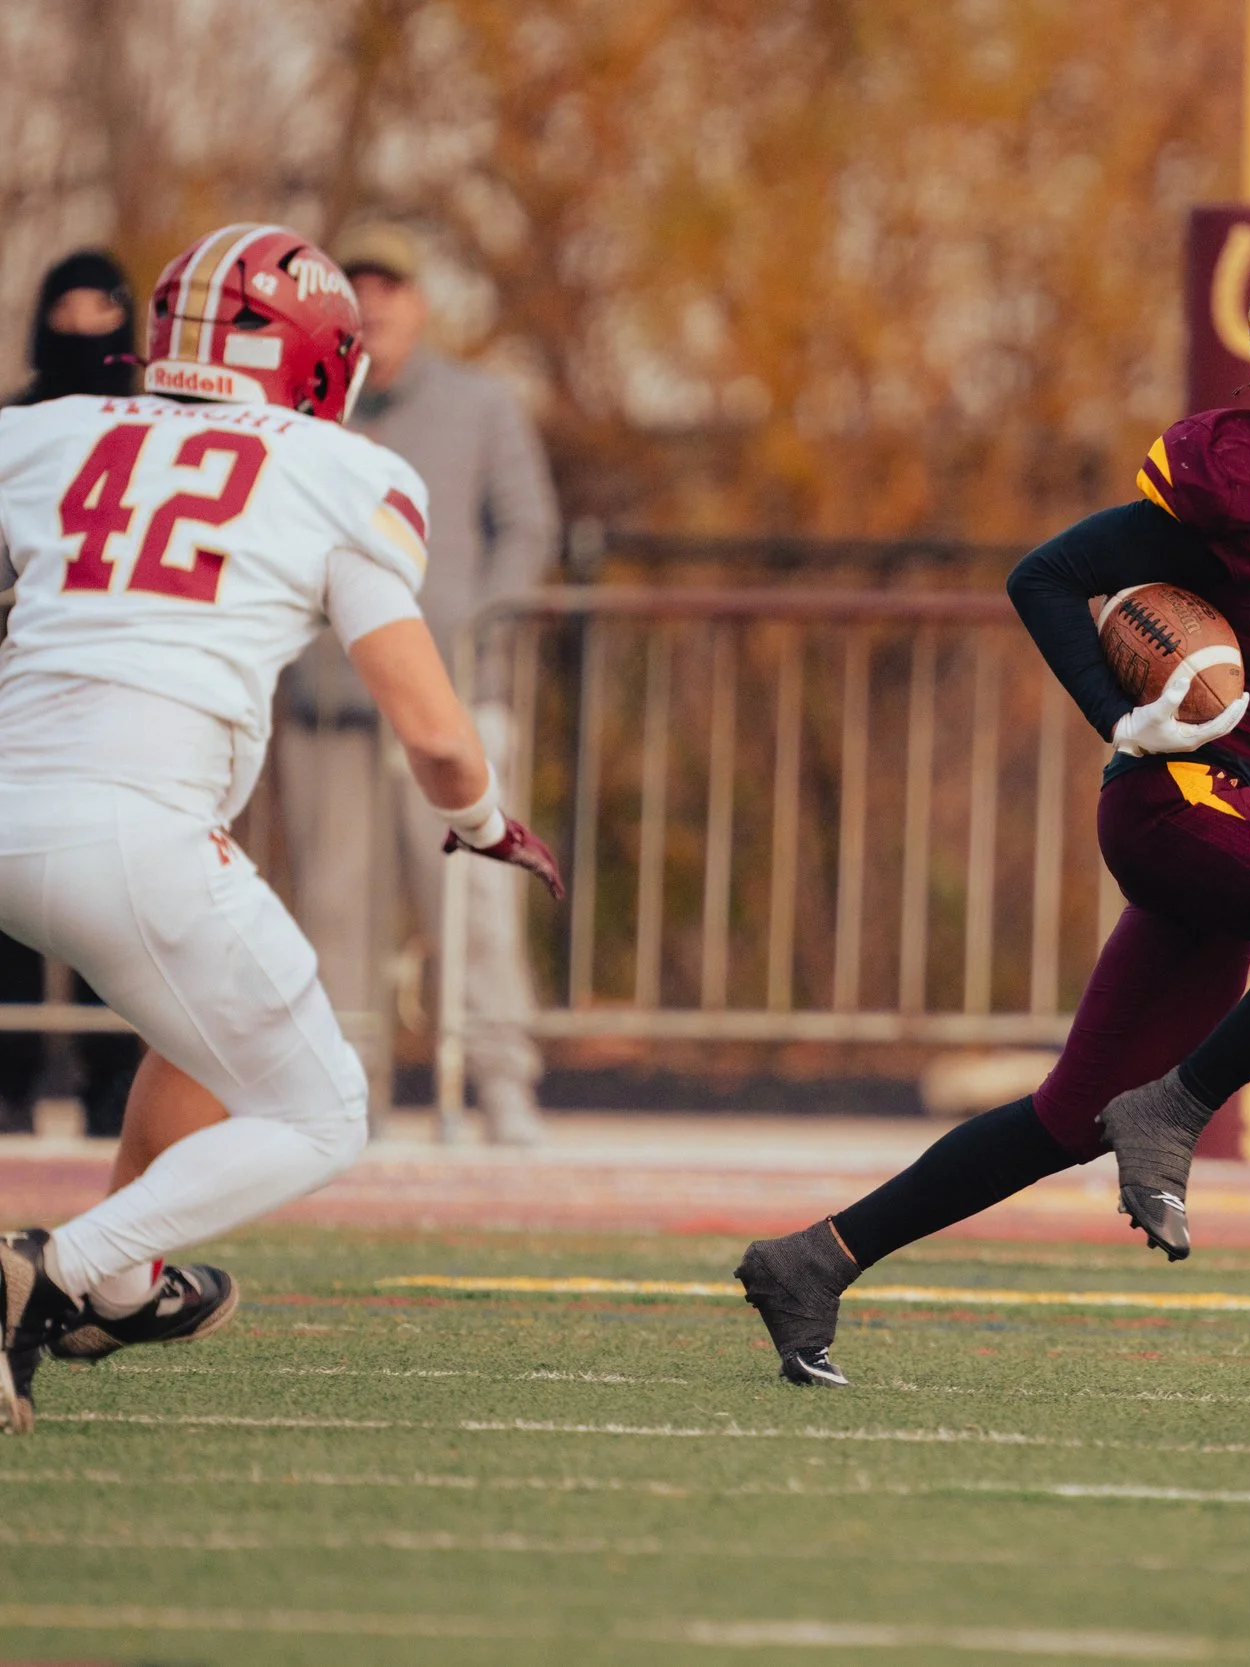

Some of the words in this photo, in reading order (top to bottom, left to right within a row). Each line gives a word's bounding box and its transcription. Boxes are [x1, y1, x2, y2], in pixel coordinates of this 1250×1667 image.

[252, 272, 278, 296] 42
[154, 367, 234, 395] Riddell
[59, 423, 268, 604] 42
